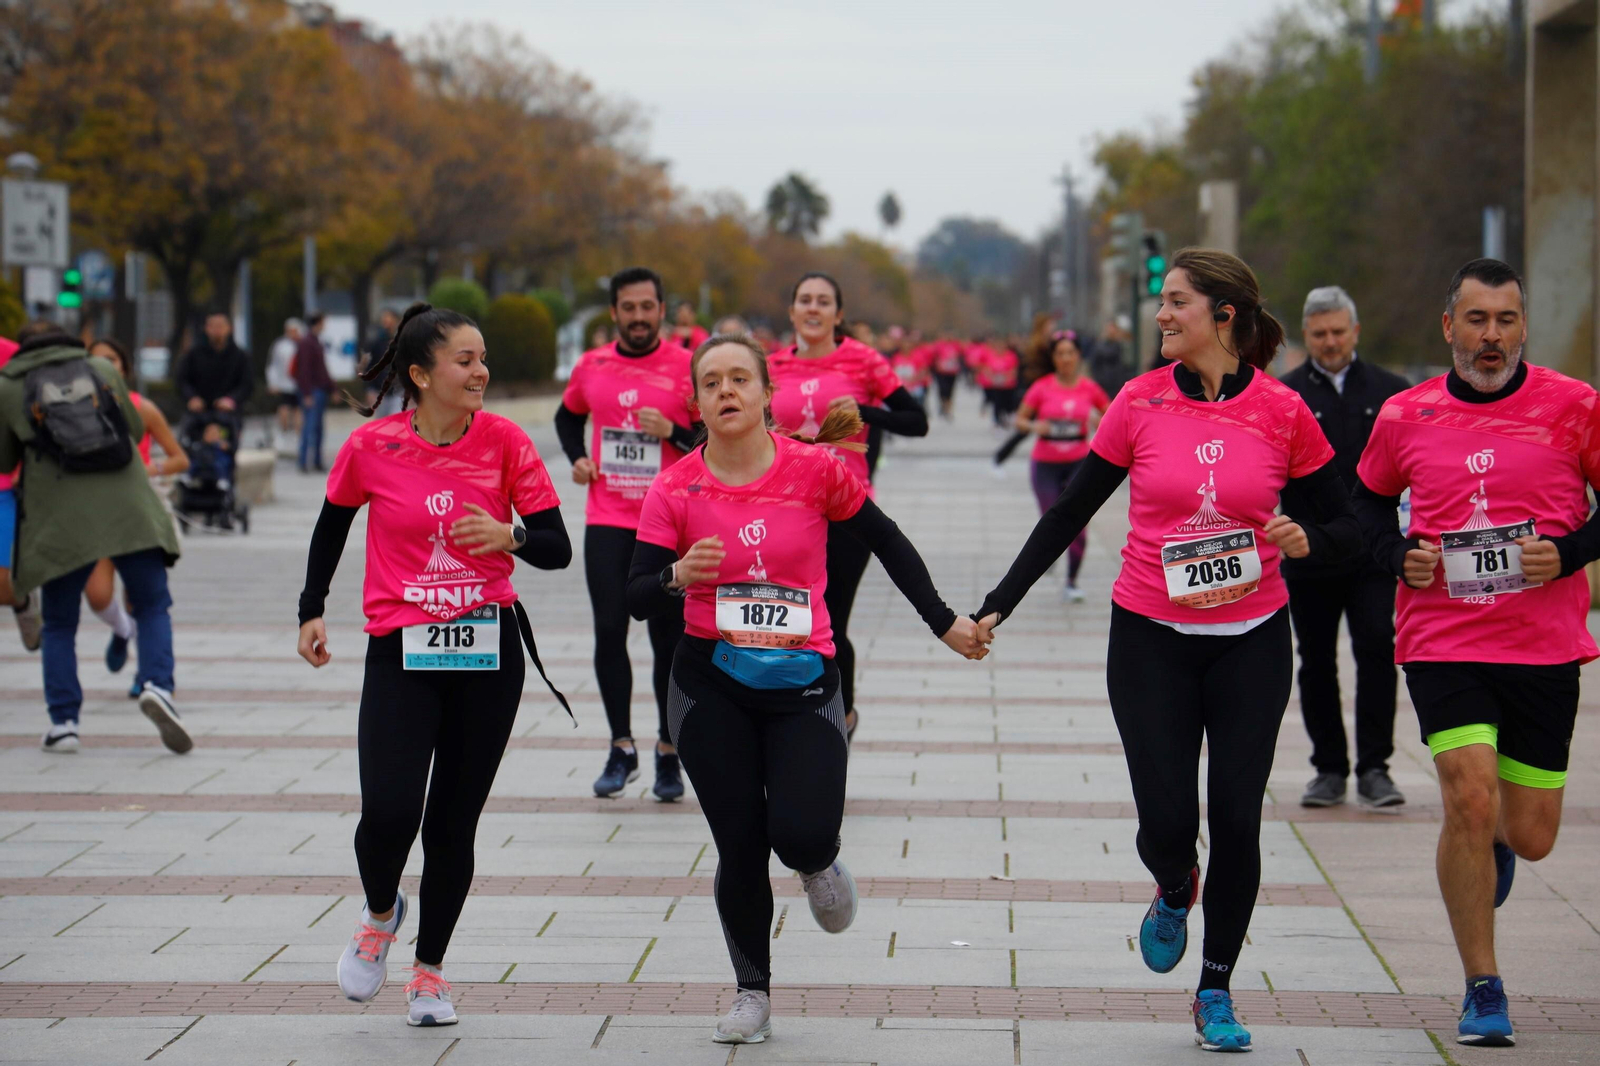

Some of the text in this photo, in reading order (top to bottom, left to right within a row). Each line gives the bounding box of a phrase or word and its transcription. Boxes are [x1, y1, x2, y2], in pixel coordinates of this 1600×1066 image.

[615, 445, 646, 461] 1451
[1195, 521, 1240, 530] EDICIÓN
[1472, 548, 1508, 573] 781
[433, 570, 475, 580] EDICIÓN
[1185, 556, 1242, 587] 2036
[404, 585, 485, 607] PINK
[740, 604, 788, 627] 1872
[427, 626, 474, 647] 2113
